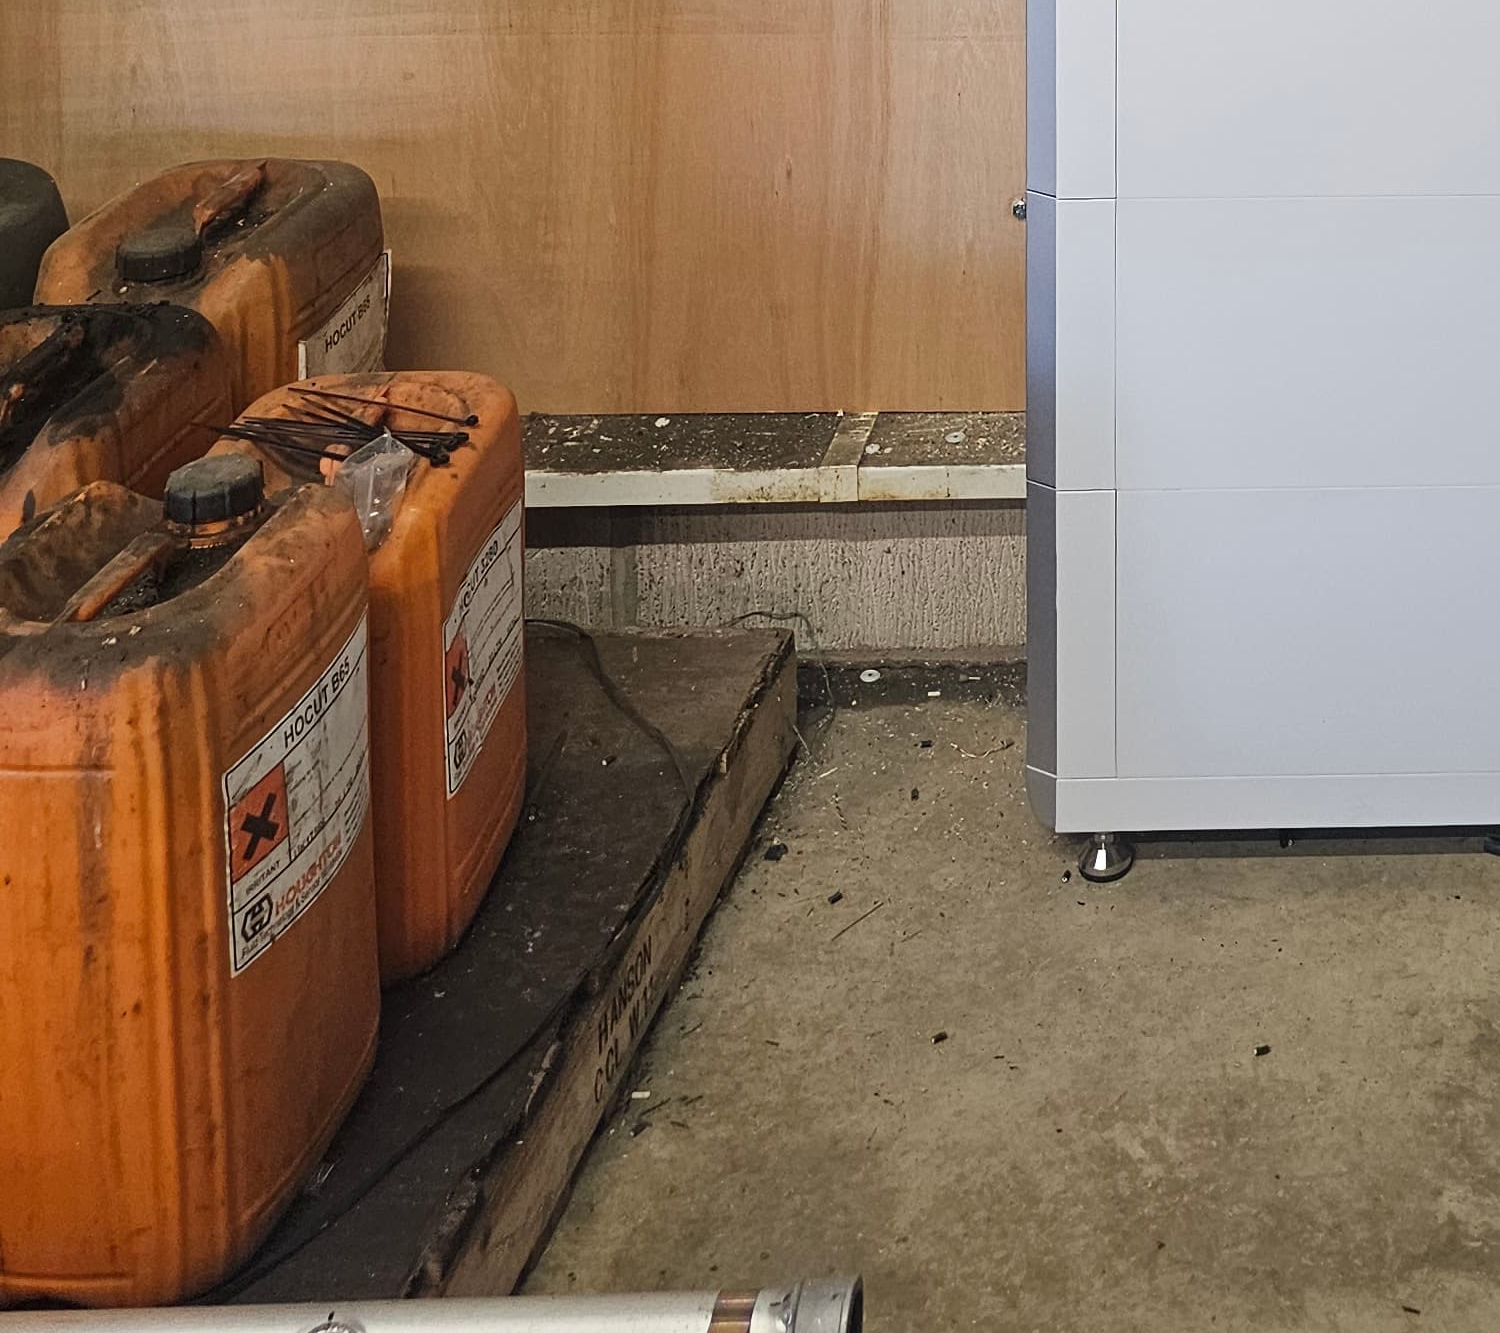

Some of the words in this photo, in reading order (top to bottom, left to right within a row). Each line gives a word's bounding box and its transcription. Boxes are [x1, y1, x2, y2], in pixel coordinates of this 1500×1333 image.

[325, 311, 357, 354] HOCUT
[283, 684, 331, 750] HOCUT
[331, 656, 350, 694] B65
[598, 934, 652, 1055] HANSON
